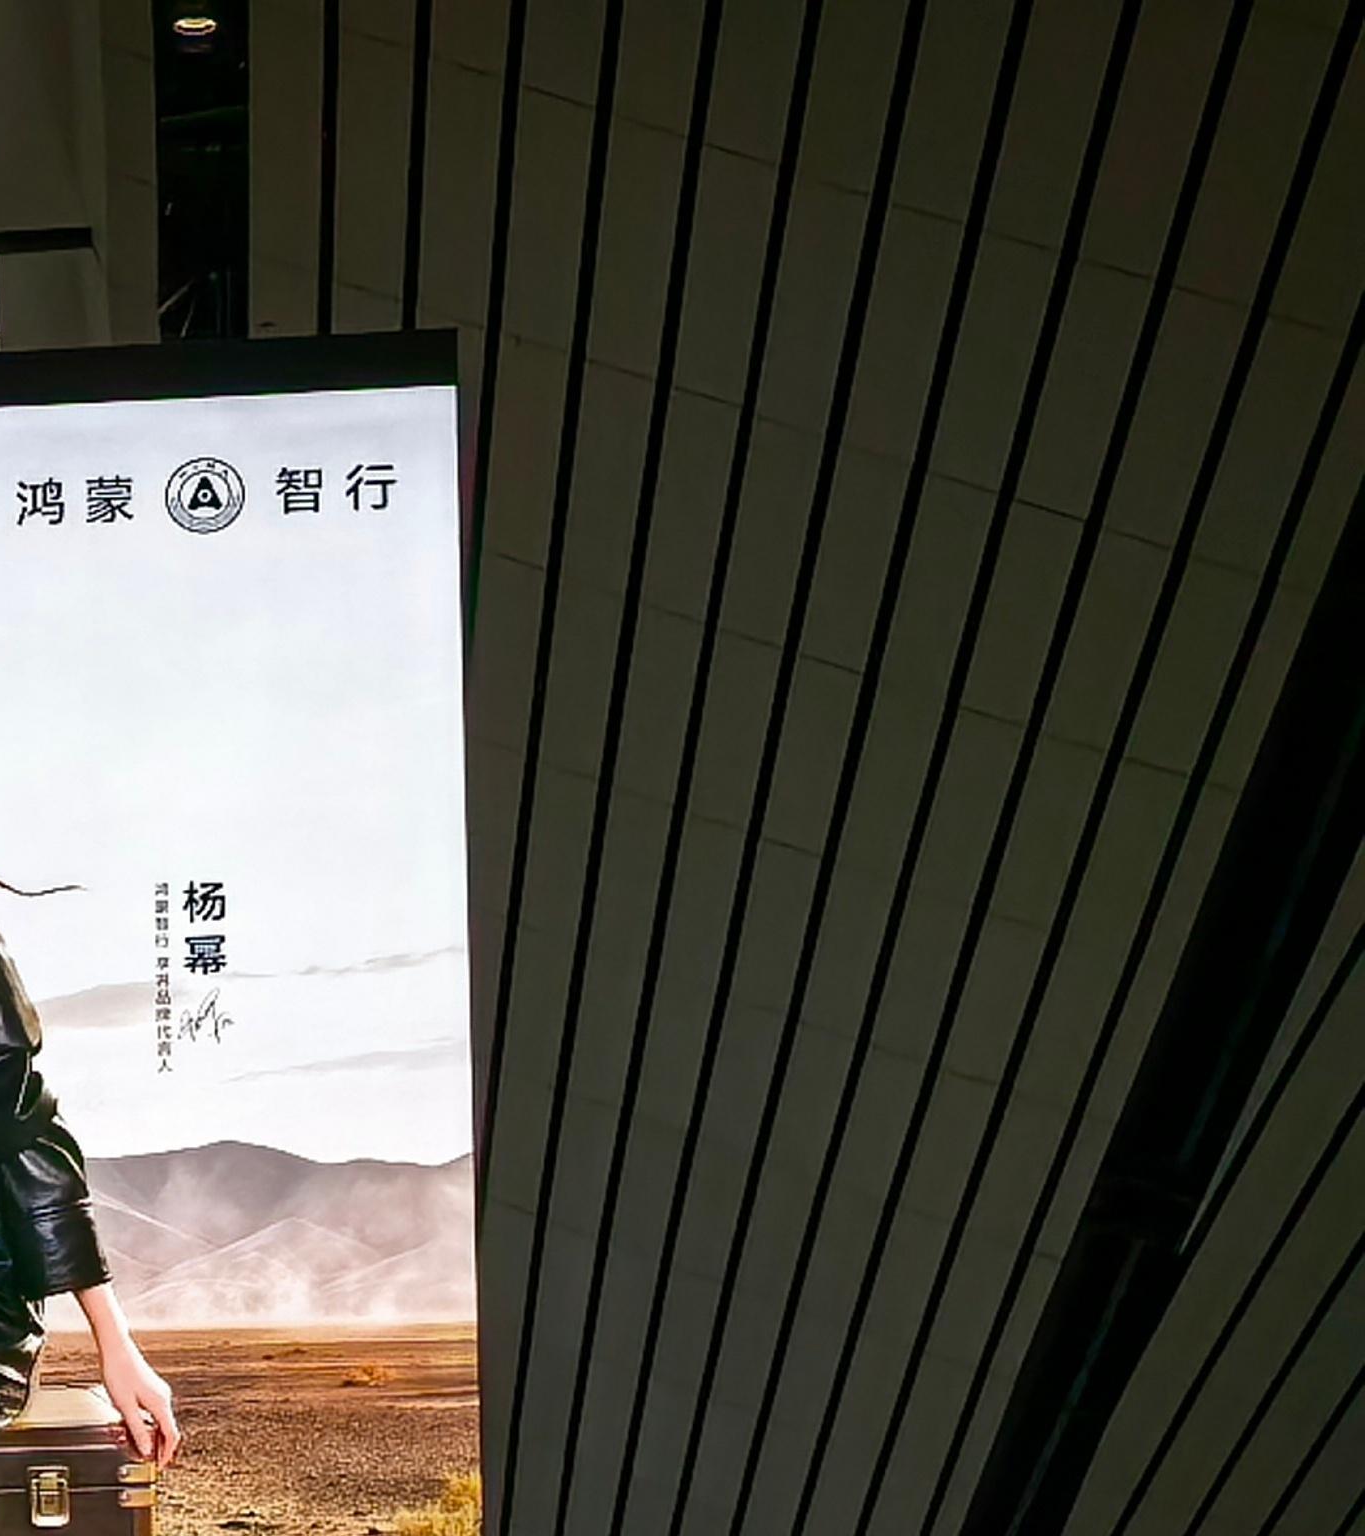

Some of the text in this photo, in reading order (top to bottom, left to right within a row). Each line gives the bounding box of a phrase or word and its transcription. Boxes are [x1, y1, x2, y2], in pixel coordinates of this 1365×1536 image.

[16, 474, 134, 526] 鸿蒙
[275, 463, 397, 515] 智行
[182, 880, 227, 975] 杨幂
